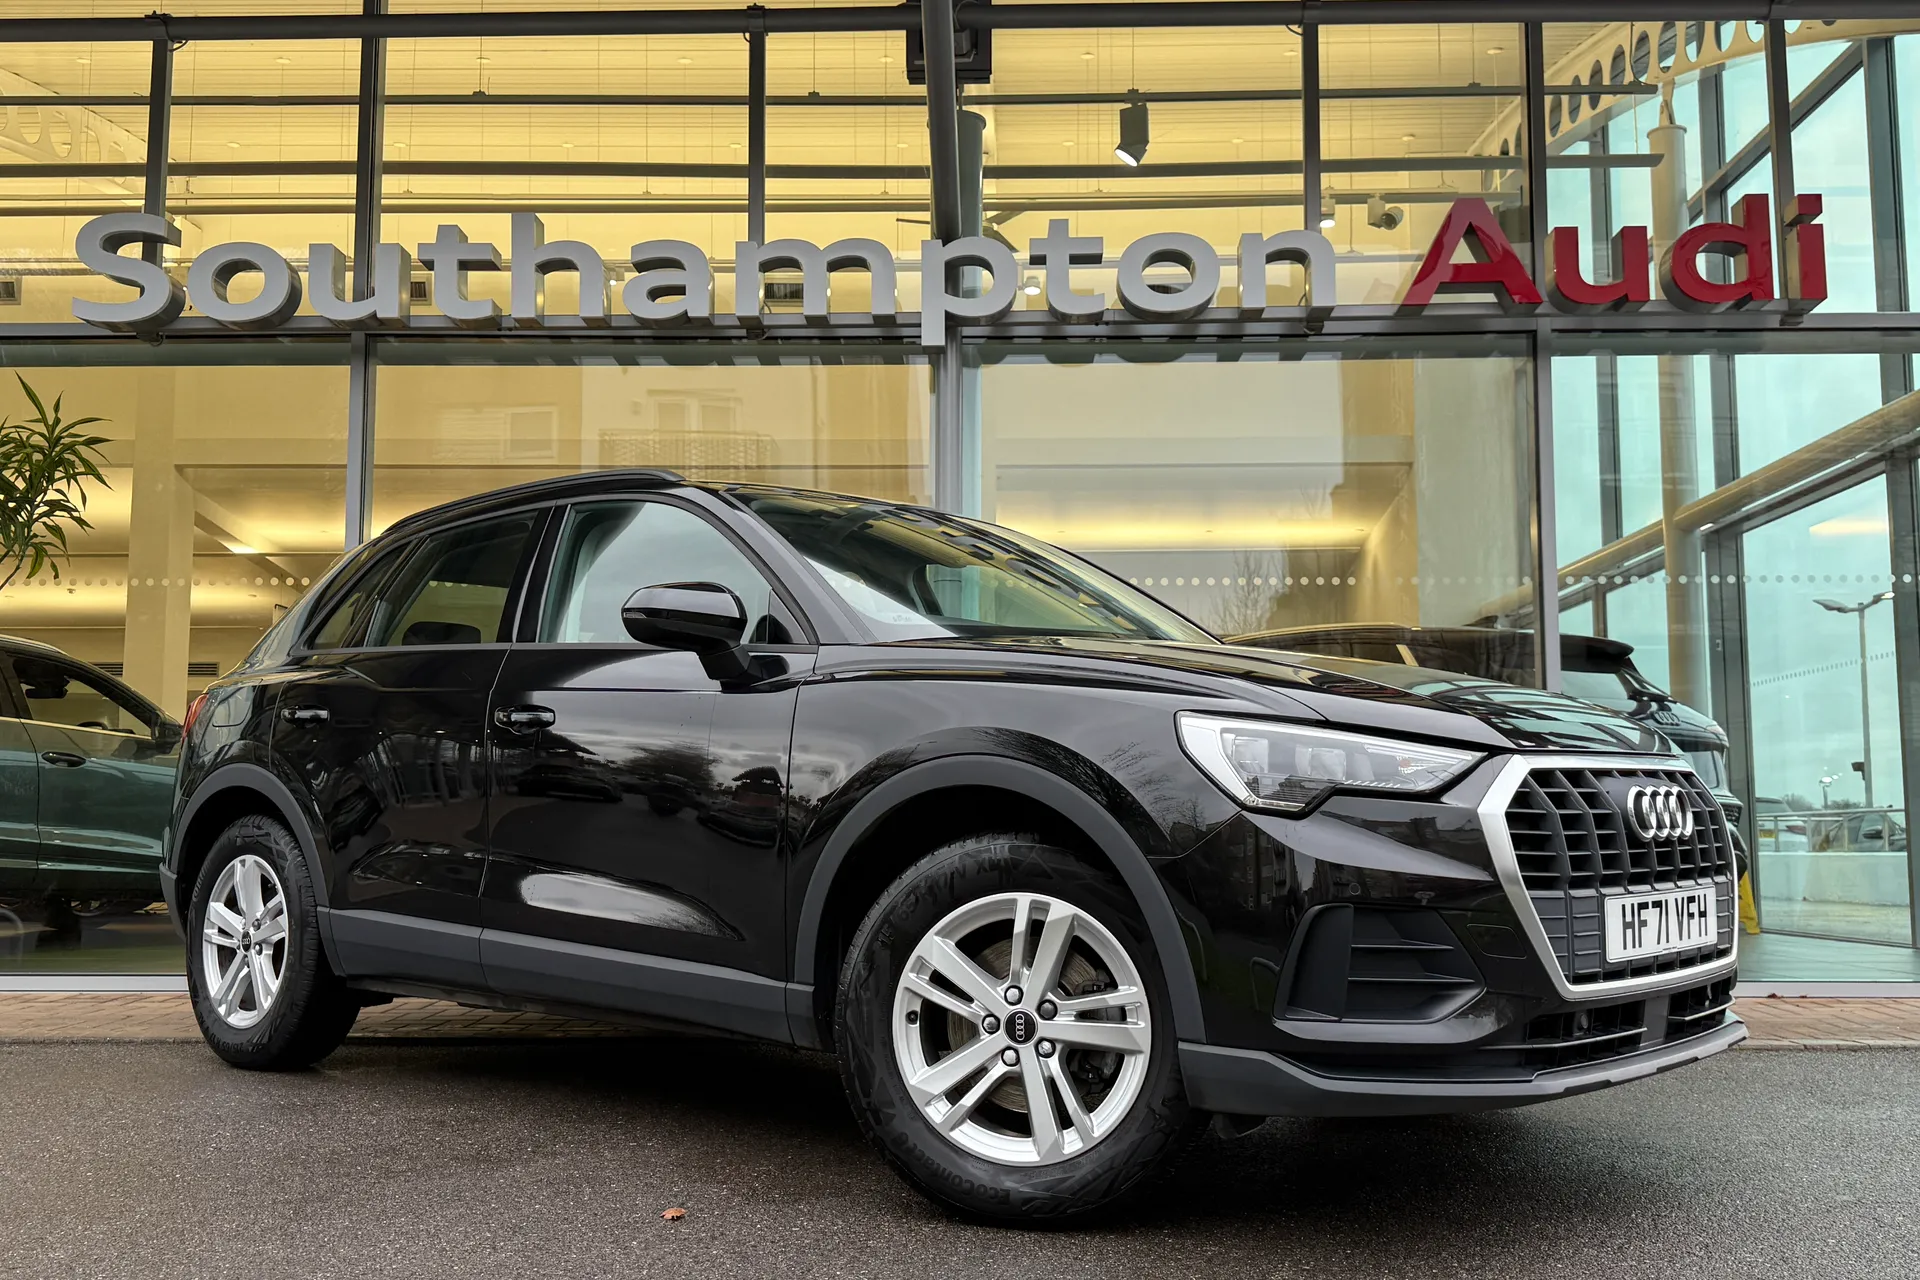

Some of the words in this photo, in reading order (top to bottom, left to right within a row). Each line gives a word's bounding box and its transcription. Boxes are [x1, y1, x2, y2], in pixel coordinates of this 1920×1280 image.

[72, 211, 1337, 350] Southampton
[1398, 193, 1828, 313] Audi
[1621, 898, 1670, 951] HF71
[1674, 893, 1708, 941] VFH
[904, 1142, 1011, 1204] EcoContact
